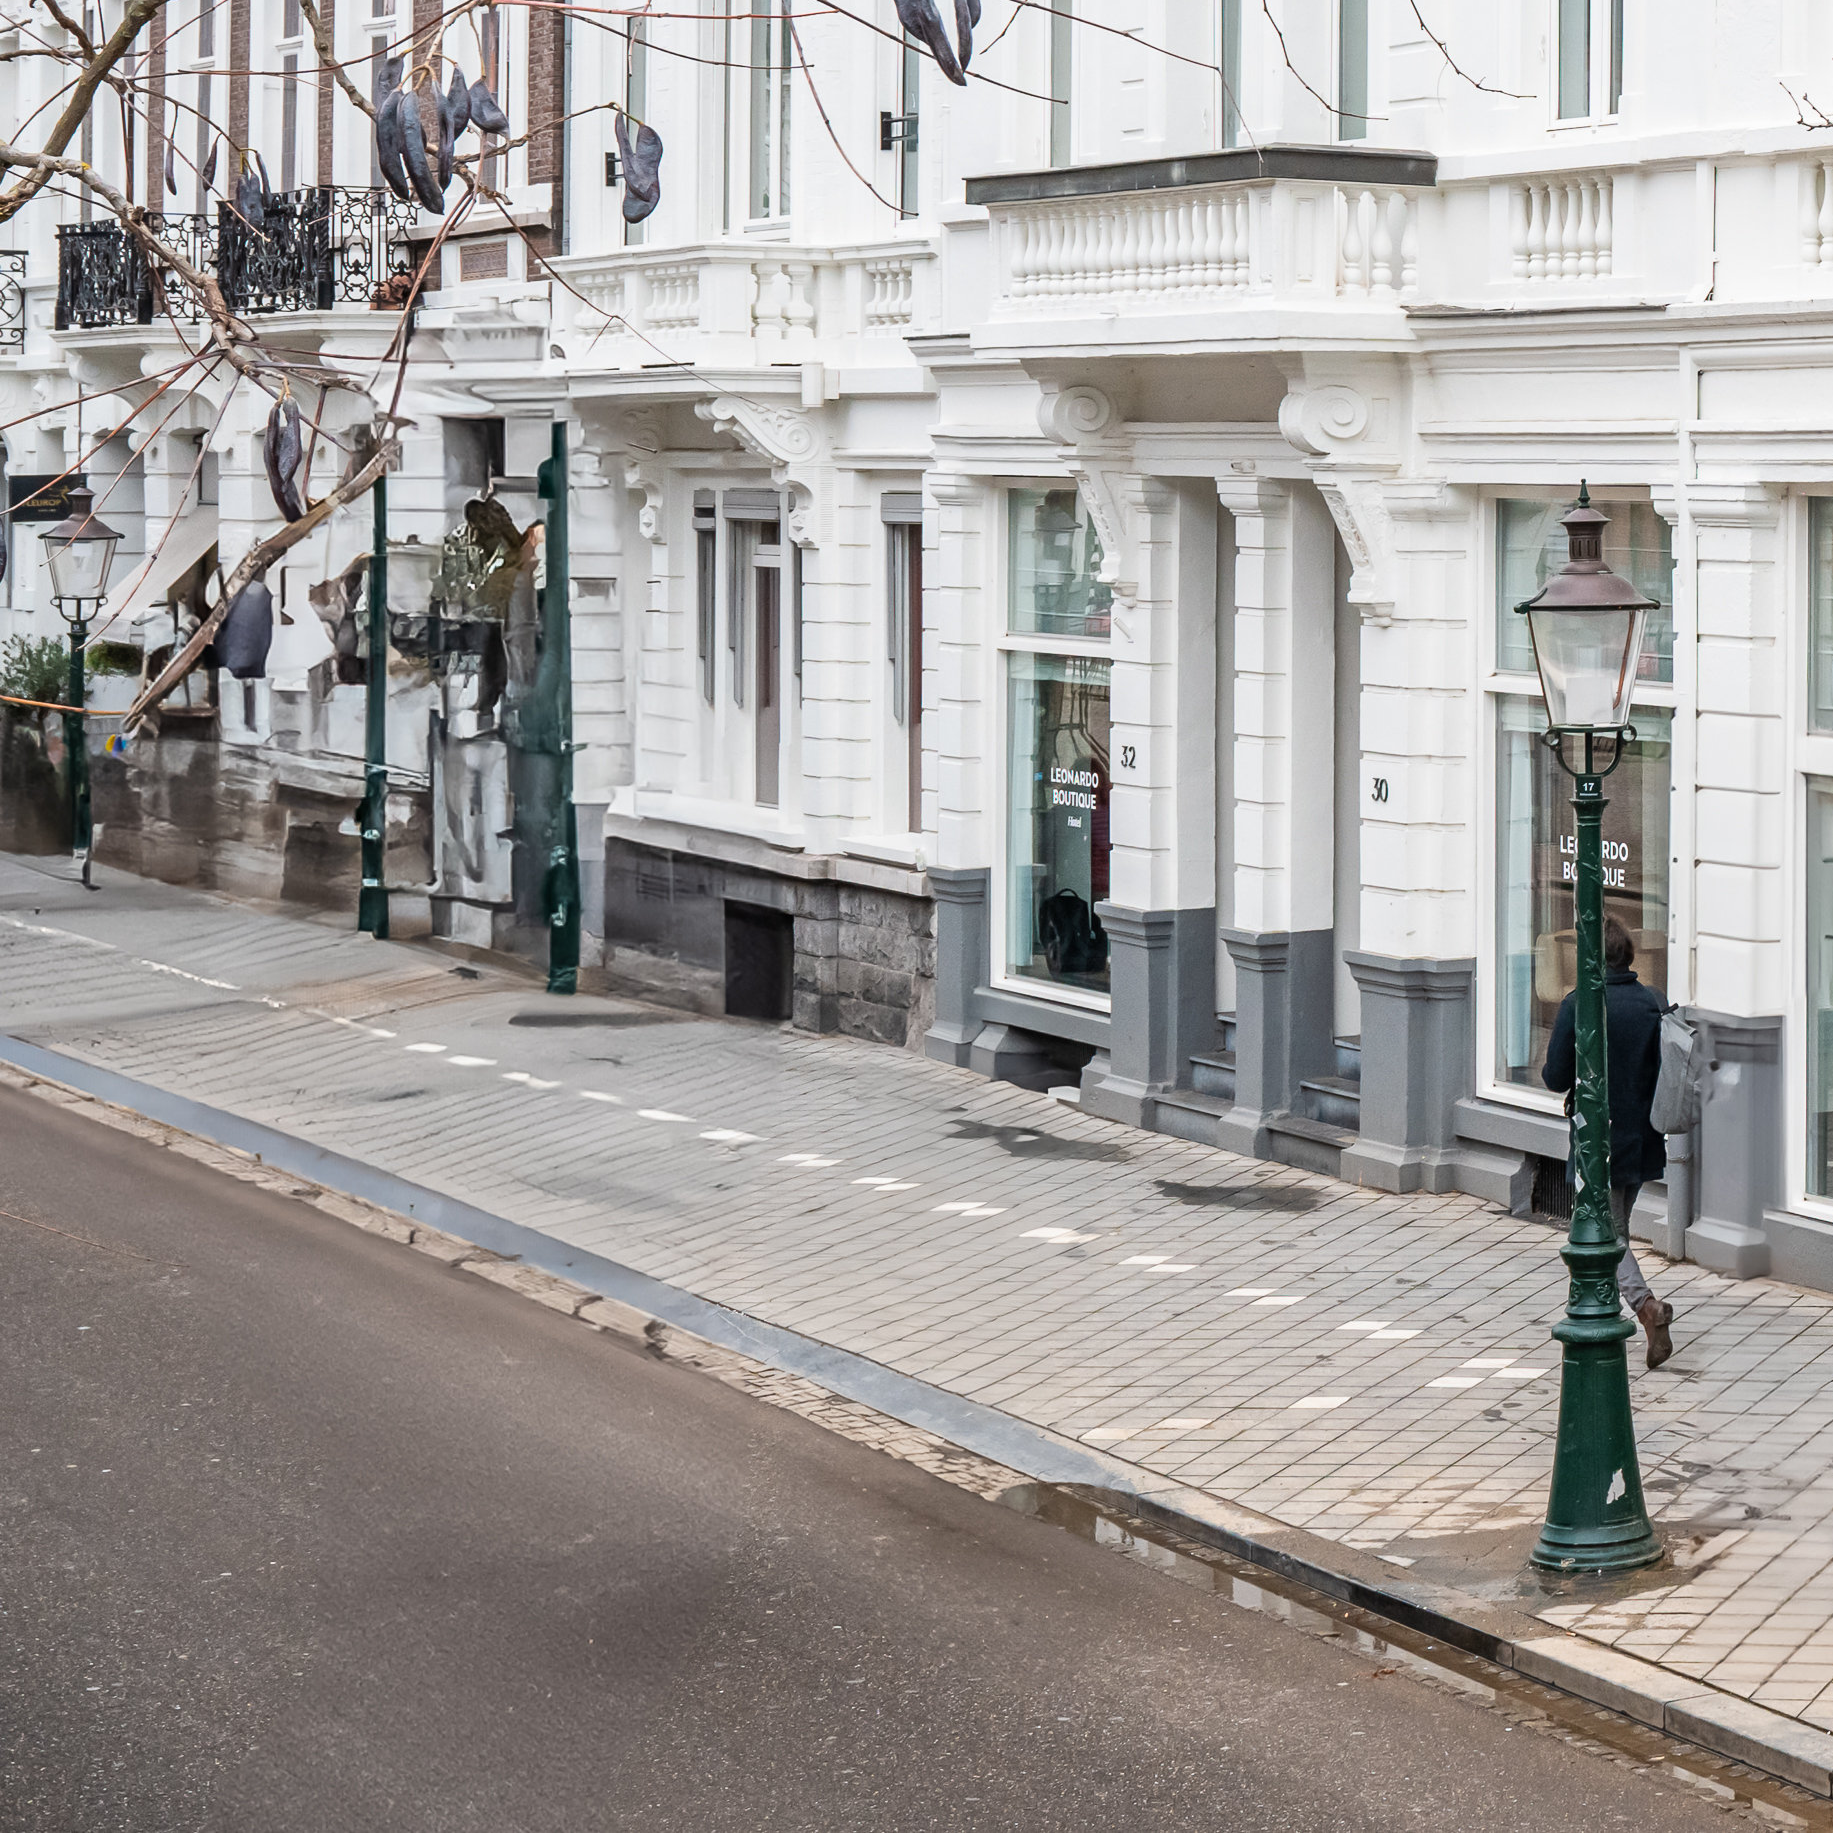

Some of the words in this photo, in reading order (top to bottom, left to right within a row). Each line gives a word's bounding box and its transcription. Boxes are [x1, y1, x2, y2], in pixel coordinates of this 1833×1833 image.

[1120, 745, 1136, 769] 32
[1050, 767, 1099, 788] LEONARDO
[1583, 782, 1595, 792] 17
[1052, 789, 1097, 810] BOUTIQUE
[1371, 777, 1389, 803] 30
[1560, 834, 1629, 862] LERDO
[1563, 861, 1625, 888] BOQUE
